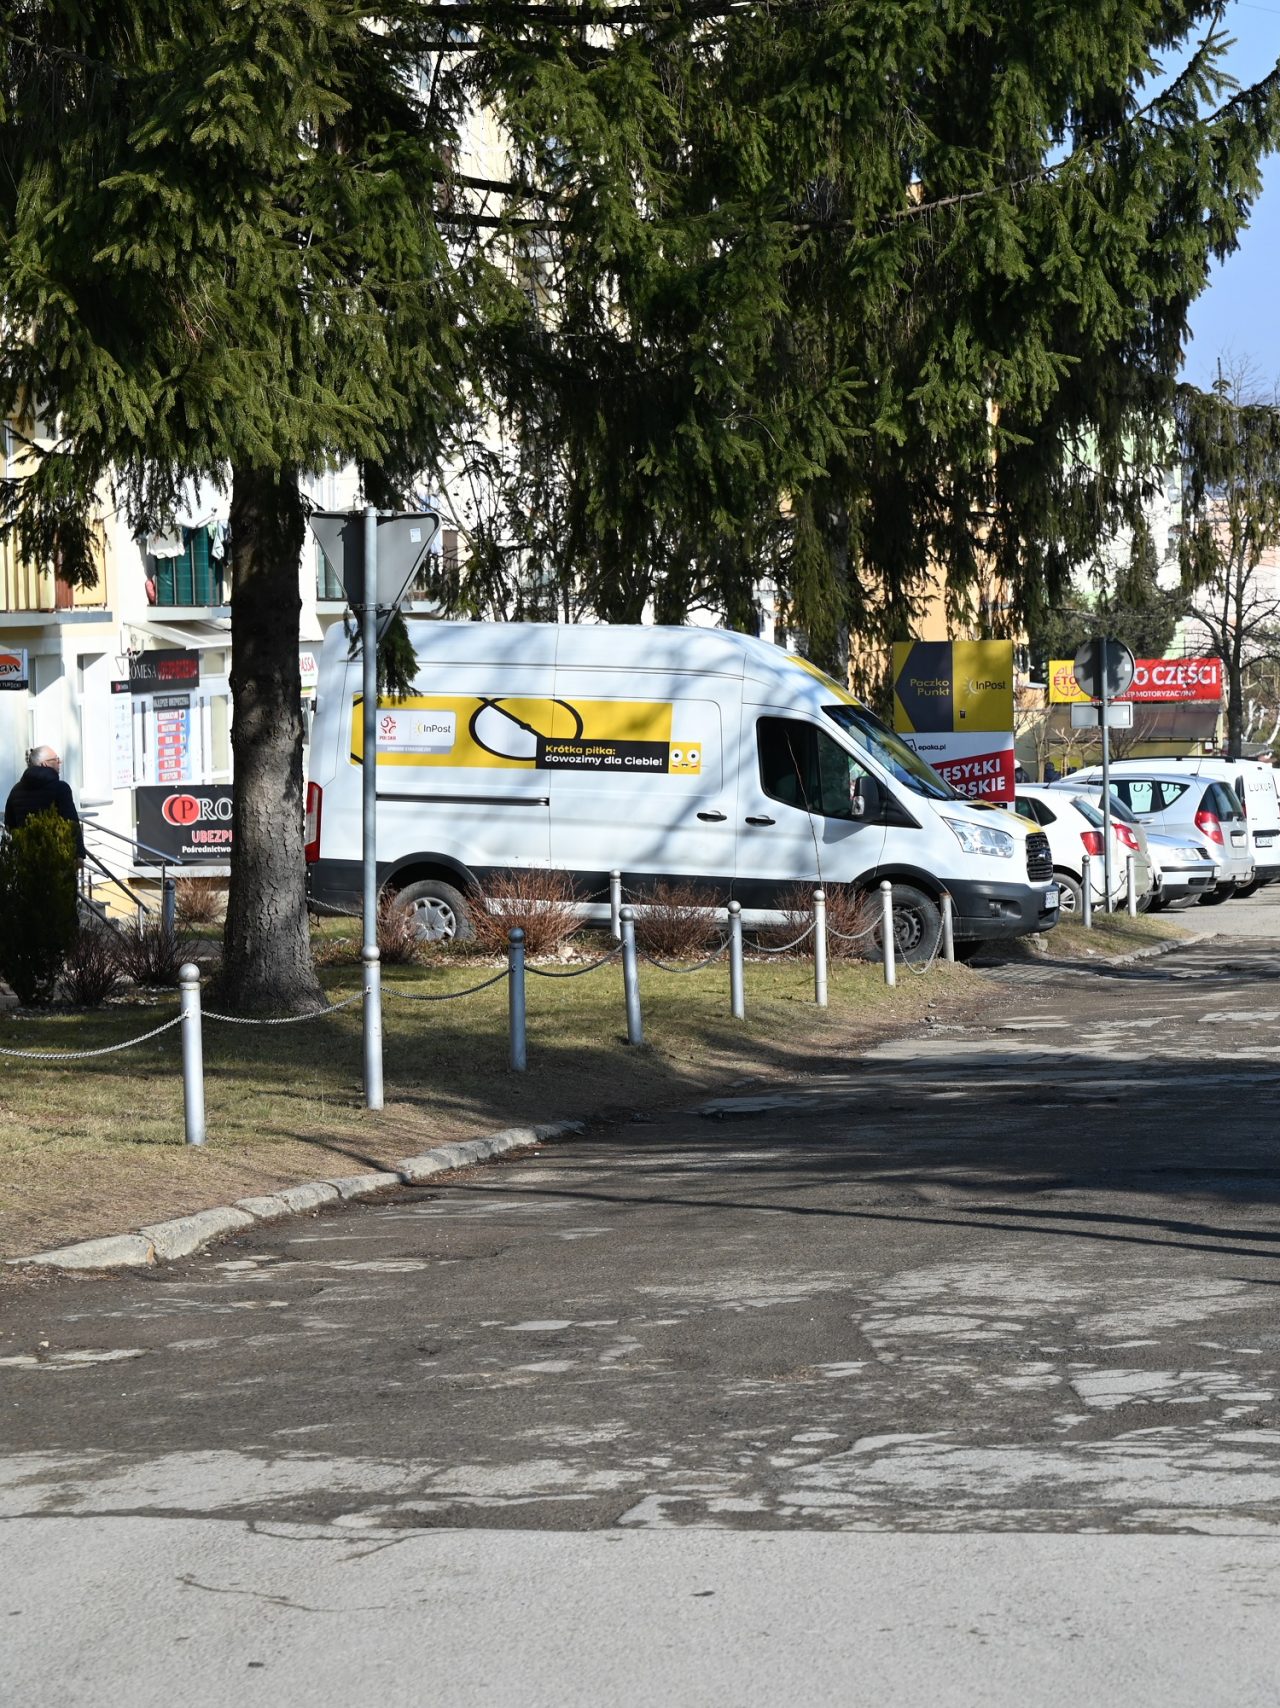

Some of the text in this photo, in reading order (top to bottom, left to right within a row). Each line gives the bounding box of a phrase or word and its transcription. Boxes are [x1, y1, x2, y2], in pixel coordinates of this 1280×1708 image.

[1152, 663, 1217, 687] CZĘŚCI
[910, 677, 950, 687] Paczko
[976, 680, 1007, 690] InPost
[917, 687, 950, 696] Punkt
[423, 724, 451, 733] InPost
[545, 744, 616, 756] Krótka piłka:
[545, 754, 663, 766] dowozimy dla Ciebie!
[181, 845, 232, 854] Pośrednictwo
